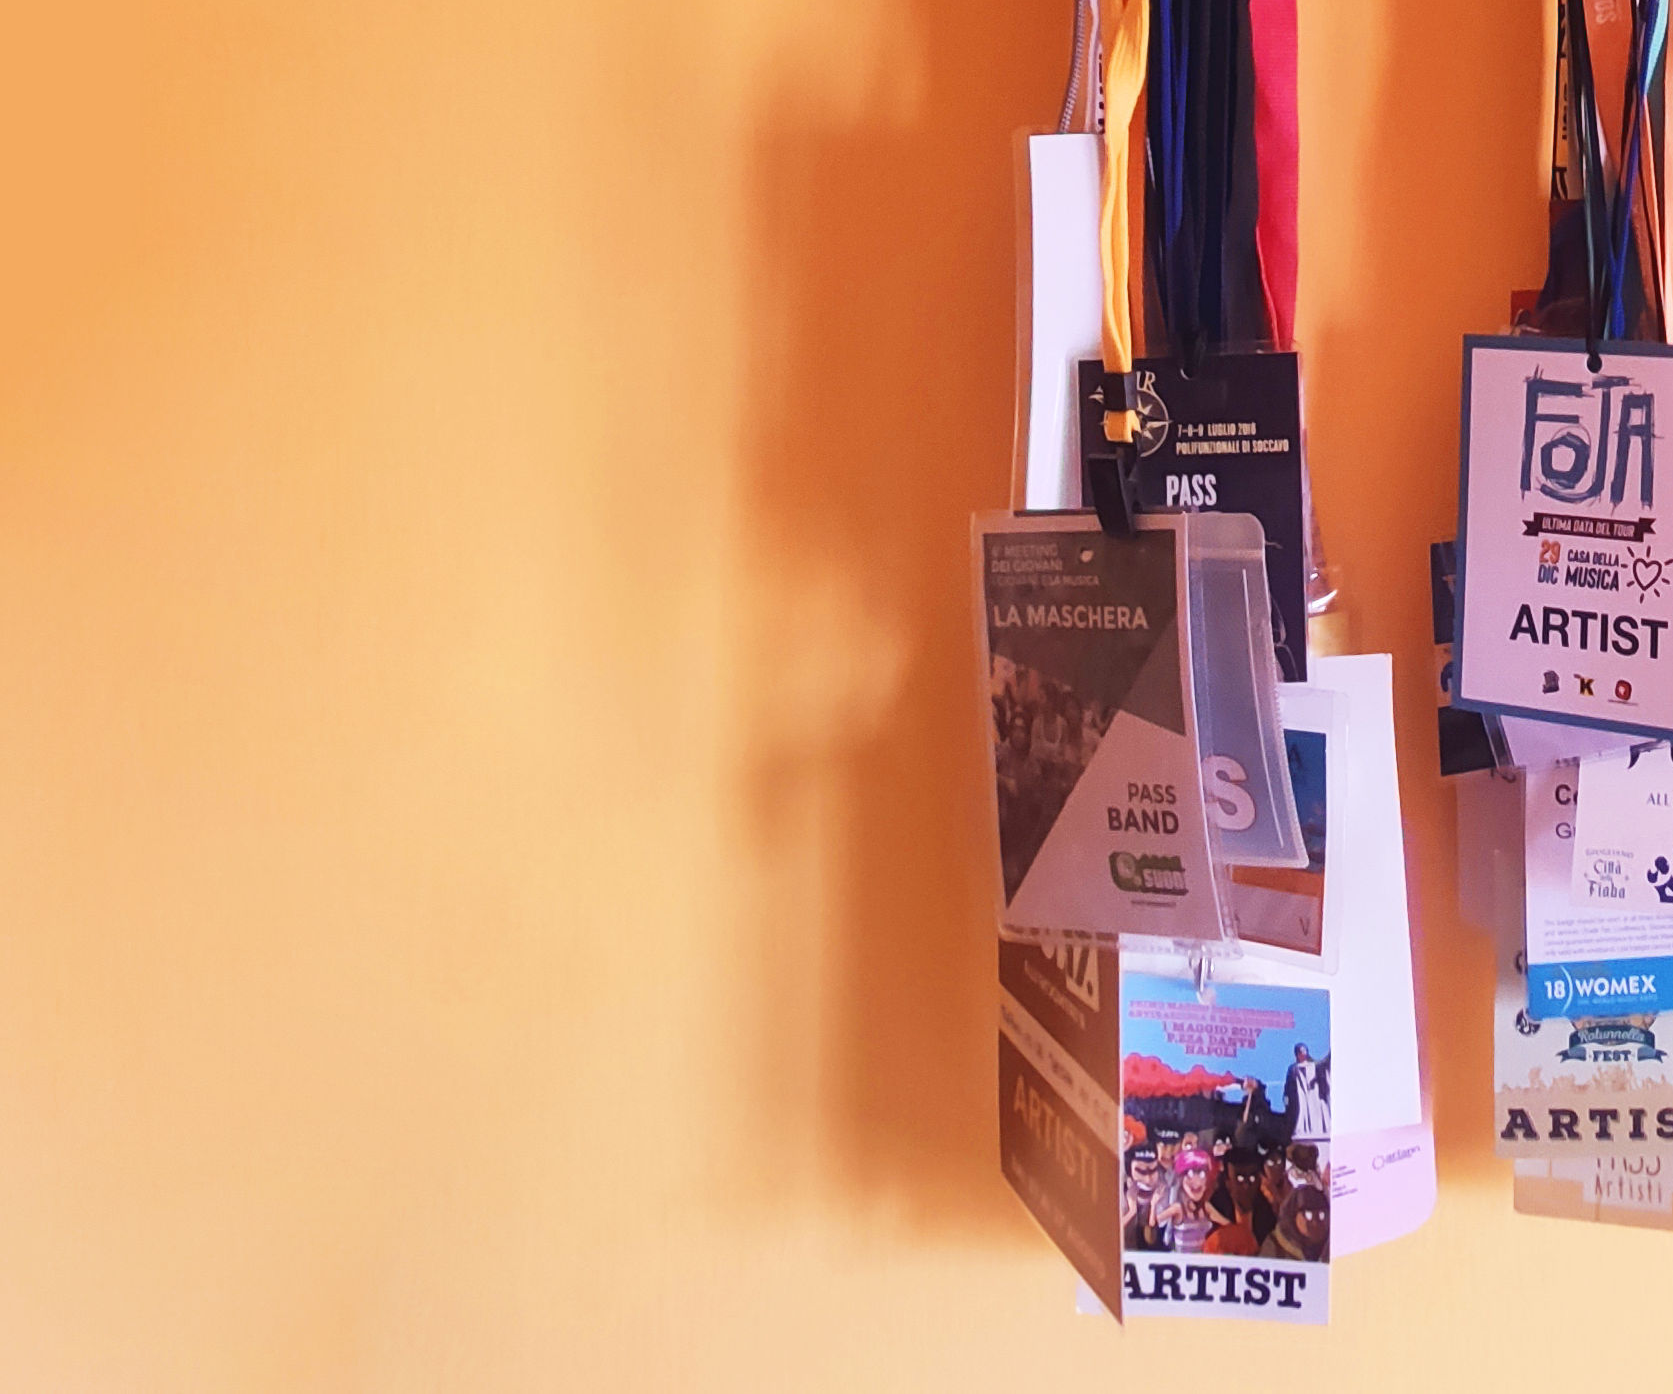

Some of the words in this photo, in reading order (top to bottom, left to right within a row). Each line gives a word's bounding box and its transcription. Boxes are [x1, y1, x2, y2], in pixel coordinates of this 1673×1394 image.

[1166, 474, 1217, 507] PASS
[1542, 518, 1571, 531] ULTIMA
[1539, 538, 1561, 565] 29
[1567, 548, 1591, 563] CASA
[1592, 551, 1620, 567] DELLA
[1537, 564, 1560, 585] DIC
[1564, 565, 1620, 592] MUSICA
[994, 605, 1022, 627] LA
[1027, 605, 1149, 630] MASCHERA
[1509, 603, 1669, 659] ARTIST
[1127, 782, 1177, 804] PASS
[1646, 793, 1670, 807] ALL
[1107, 807, 1180, 834] BAND
[1575, 974, 1657, 997] WOMEX
[1592, 1049, 1632, 1062] FEST
[1595, 1173, 1662, 1203] Artisti
[1123, 1262, 1307, 1309] ARTIST
